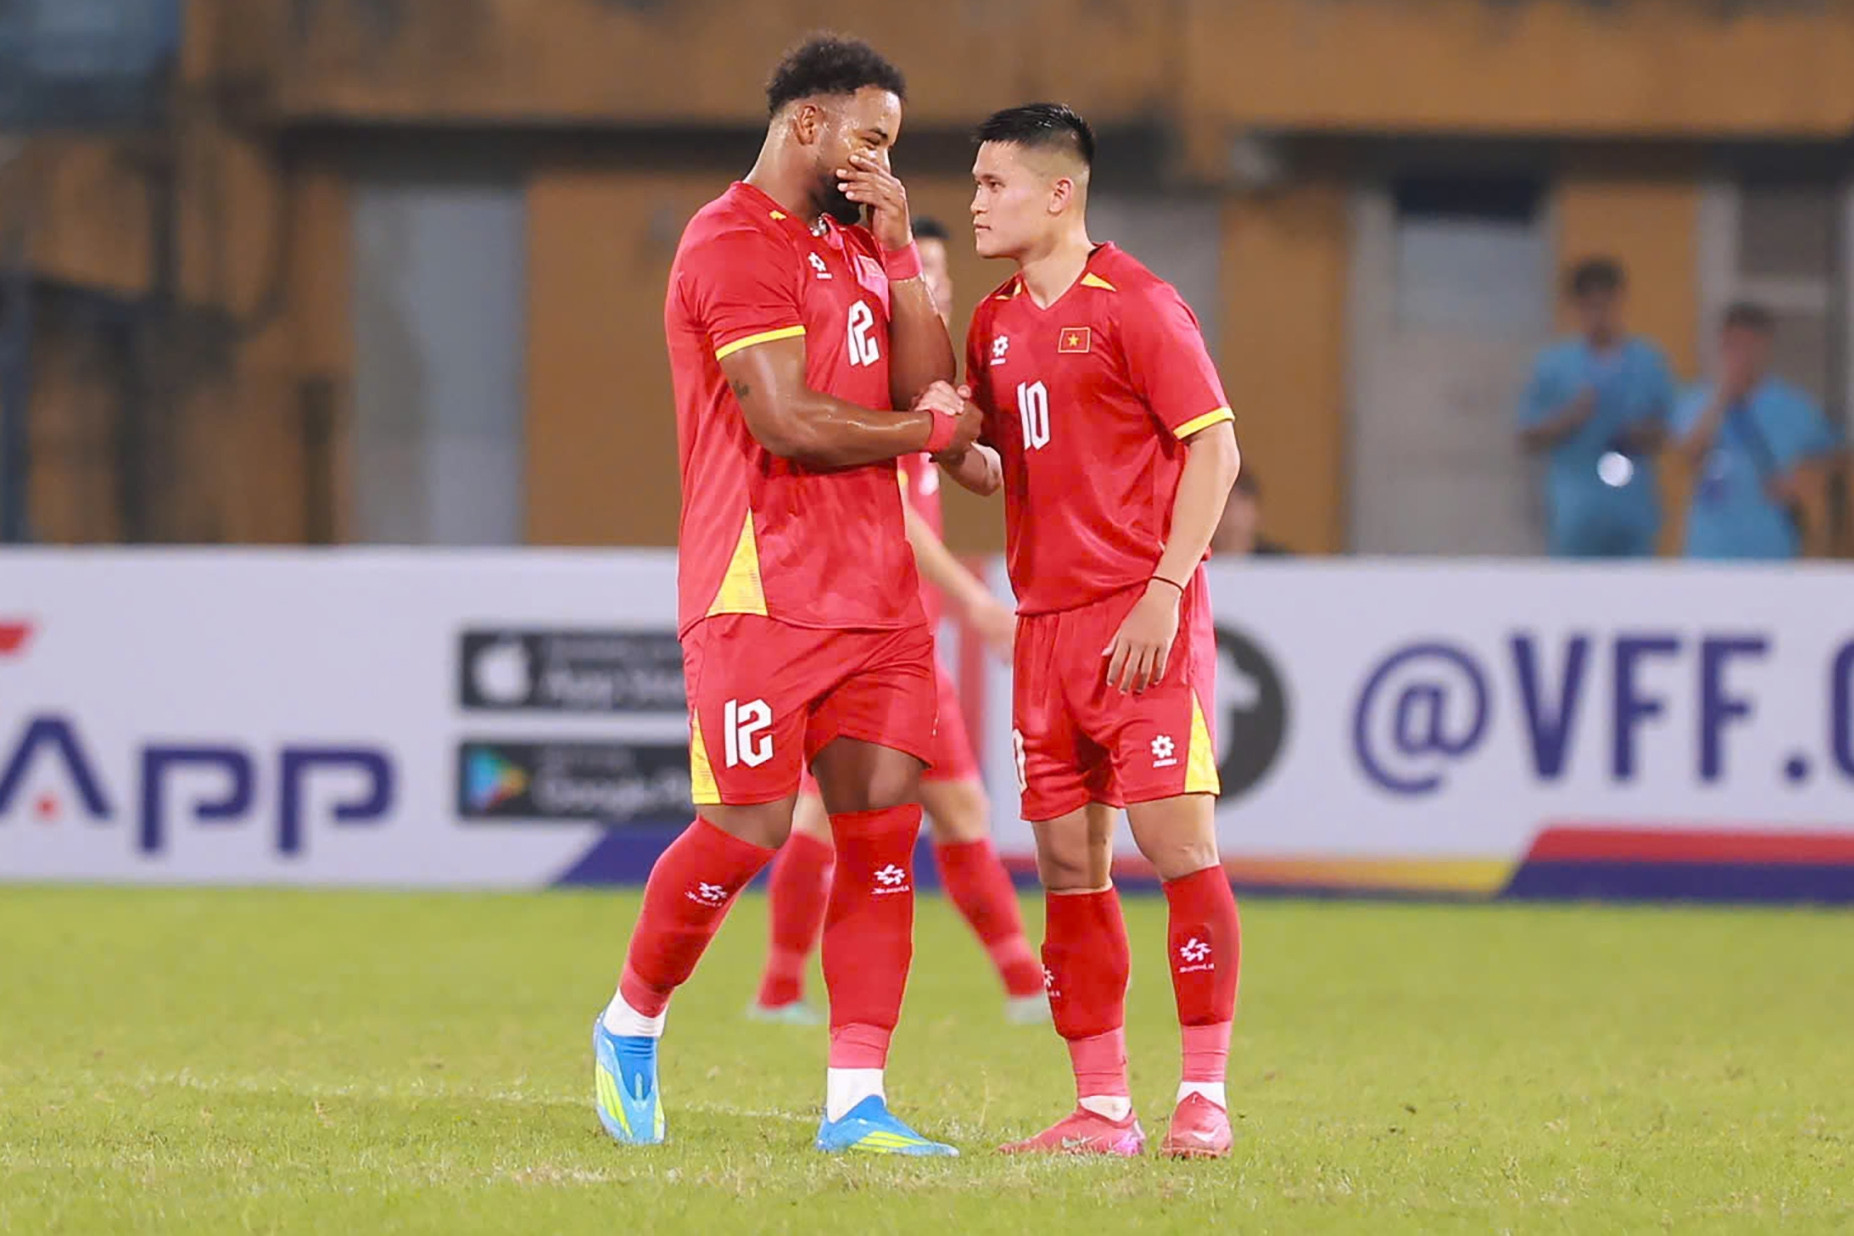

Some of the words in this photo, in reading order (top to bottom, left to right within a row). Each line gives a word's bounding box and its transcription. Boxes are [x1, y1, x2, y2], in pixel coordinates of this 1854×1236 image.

[847, 299, 880, 368] 12
[1017, 380, 1051, 451] 10
[724, 699, 773, 768] 12
